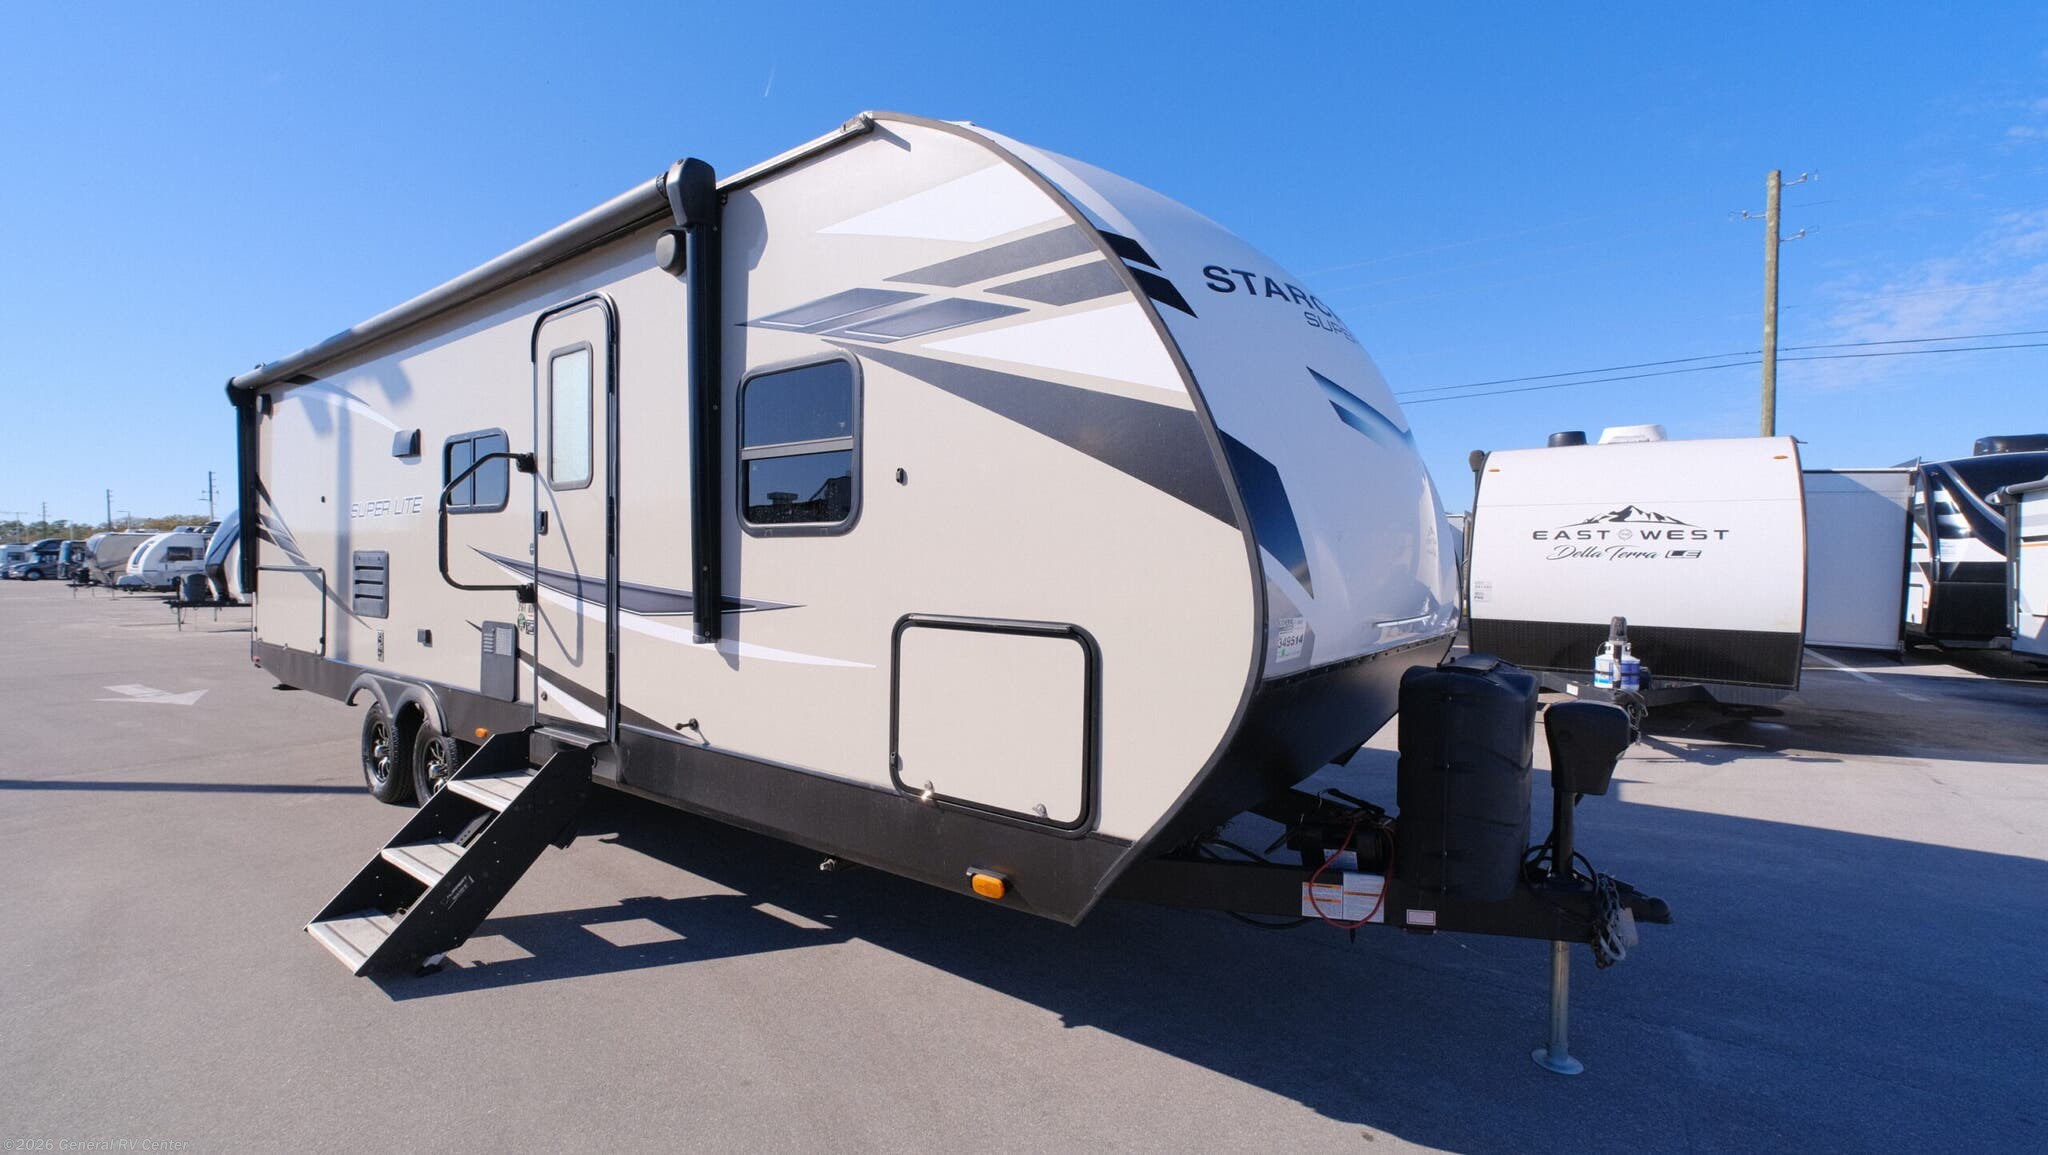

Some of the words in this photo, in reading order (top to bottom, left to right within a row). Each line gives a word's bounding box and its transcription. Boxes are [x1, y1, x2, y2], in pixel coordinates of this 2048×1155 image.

[1203, 265, 1340, 322] STARC
[351, 500, 390, 518] SUPER
[394, 496, 423, 515] LITE
[1532, 529, 1611, 541] EAST
[1640, 529, 1730, 541] WEST
[1546, 544, 1602, 561] Della
[1604, 544, 1658, 562] Terra
